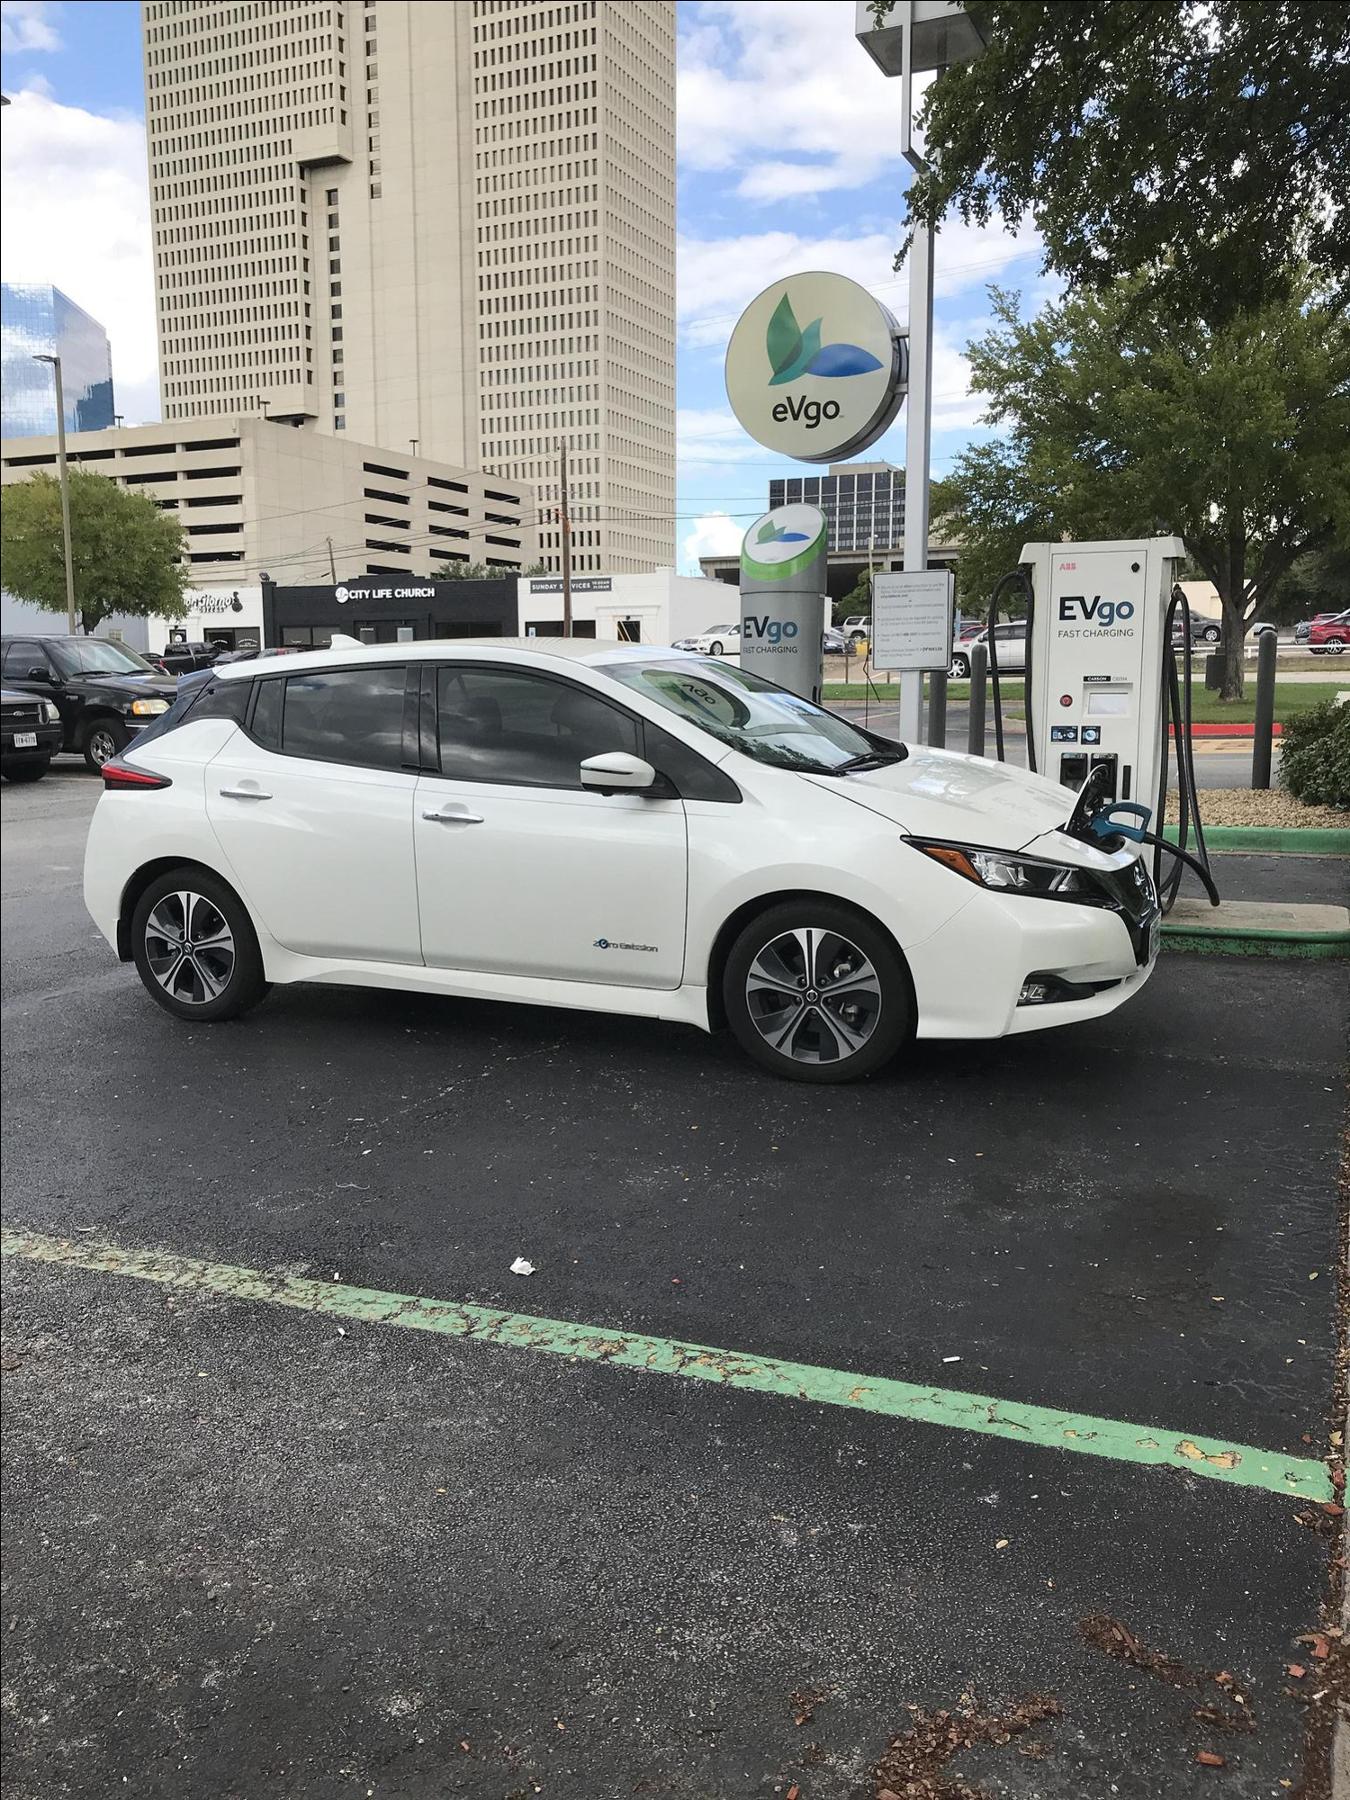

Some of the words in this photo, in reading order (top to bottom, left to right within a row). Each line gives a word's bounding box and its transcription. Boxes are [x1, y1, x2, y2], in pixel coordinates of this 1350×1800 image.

[772, 395, 840, 429] eVgo
[559, 582, 591, 590] SVICES
[349, 589, 370, 599] CITY
[372, 588, 393, 599] LIFE
[394, 587, 435, 598] CHURCH
[1059, 595, 1134, 627] EVgo
[743, 615, 798, 644] EVgo
[1058, 629, 1080, 638] FAST
[1082, 628, 1134, 638] CHARGING
[755, 646, 798, 654] CHARGING
